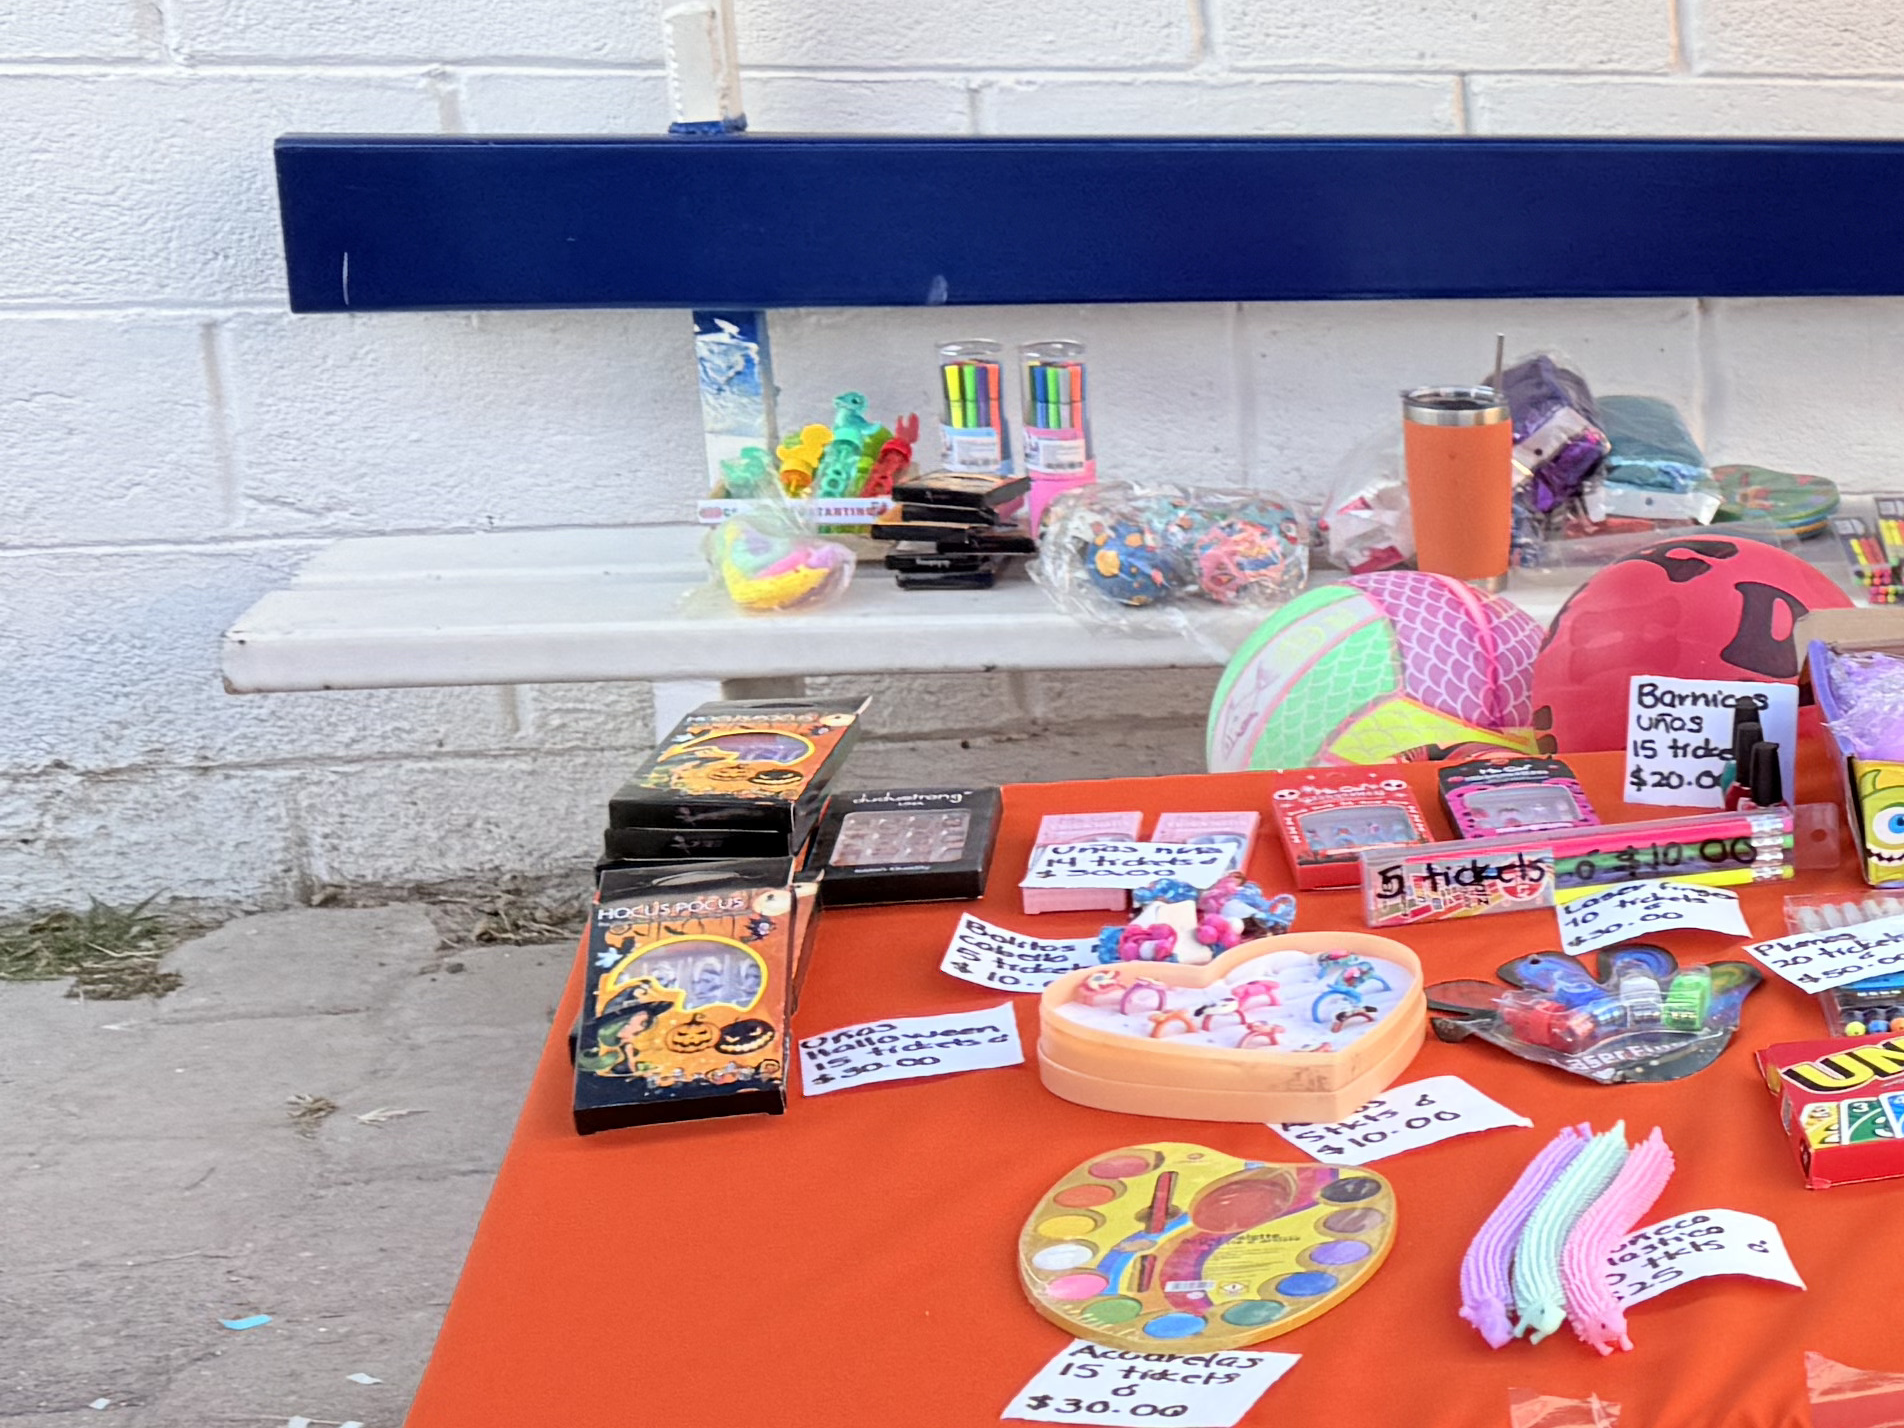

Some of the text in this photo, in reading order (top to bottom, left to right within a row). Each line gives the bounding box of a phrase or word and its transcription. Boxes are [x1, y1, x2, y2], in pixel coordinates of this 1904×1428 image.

[1634, 740, 1657, 759] 15
[597, 897, 744, 921] HOCUS POCUS
[1069, 1345, 1263, 1368] Acuarelas
[1060, 1363, 1103, 1378] 15
[1027, 1395, 1188, 1417] $30.00
